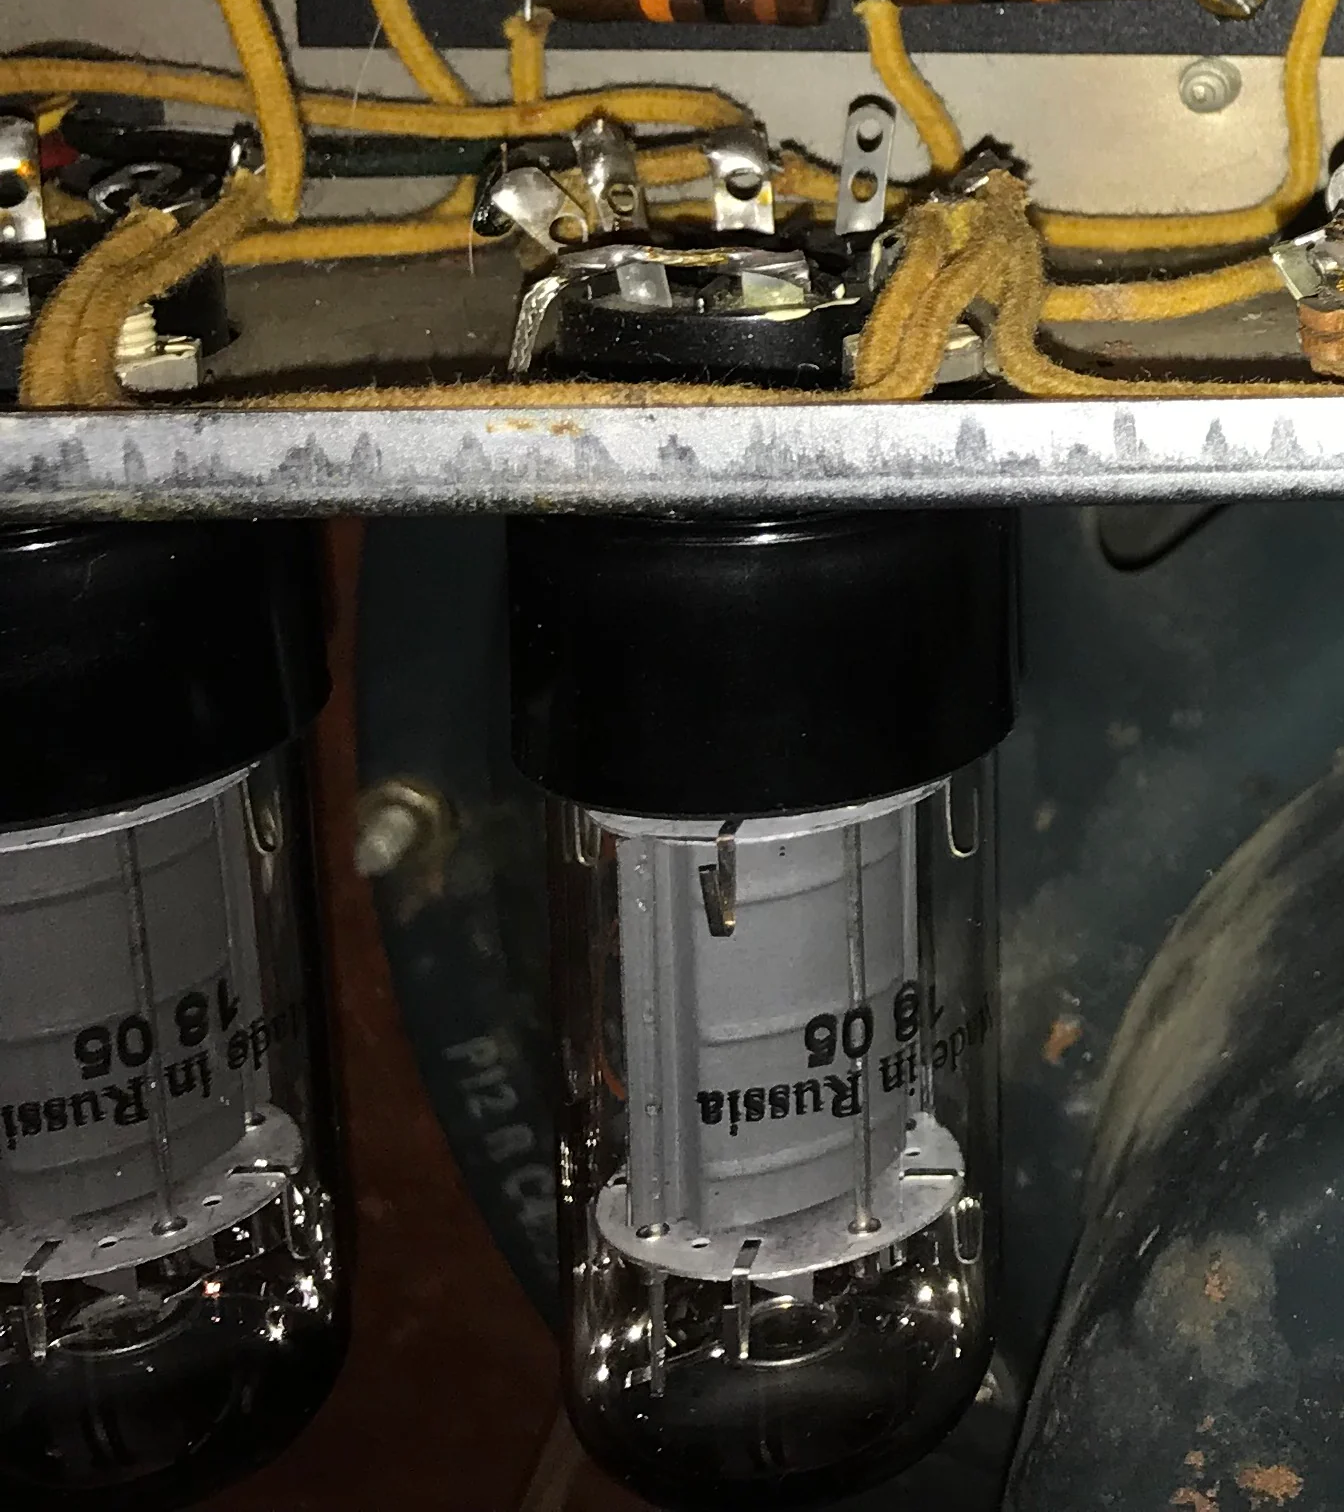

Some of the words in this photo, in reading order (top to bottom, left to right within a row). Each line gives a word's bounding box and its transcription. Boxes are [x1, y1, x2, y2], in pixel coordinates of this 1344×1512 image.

[175, 979, 239, 1047] 18
[805, 1008, 873, 1068] 05
[894, 981, 943, 1042] 18
[74, 1015, 152, 1080] 05
[164, 1050, 211, 1098] in
[879, 1047, 917, 1096] in
[0, 1076, 148, 1158] Russi
[697, 1071, 862, 1137] Russia
